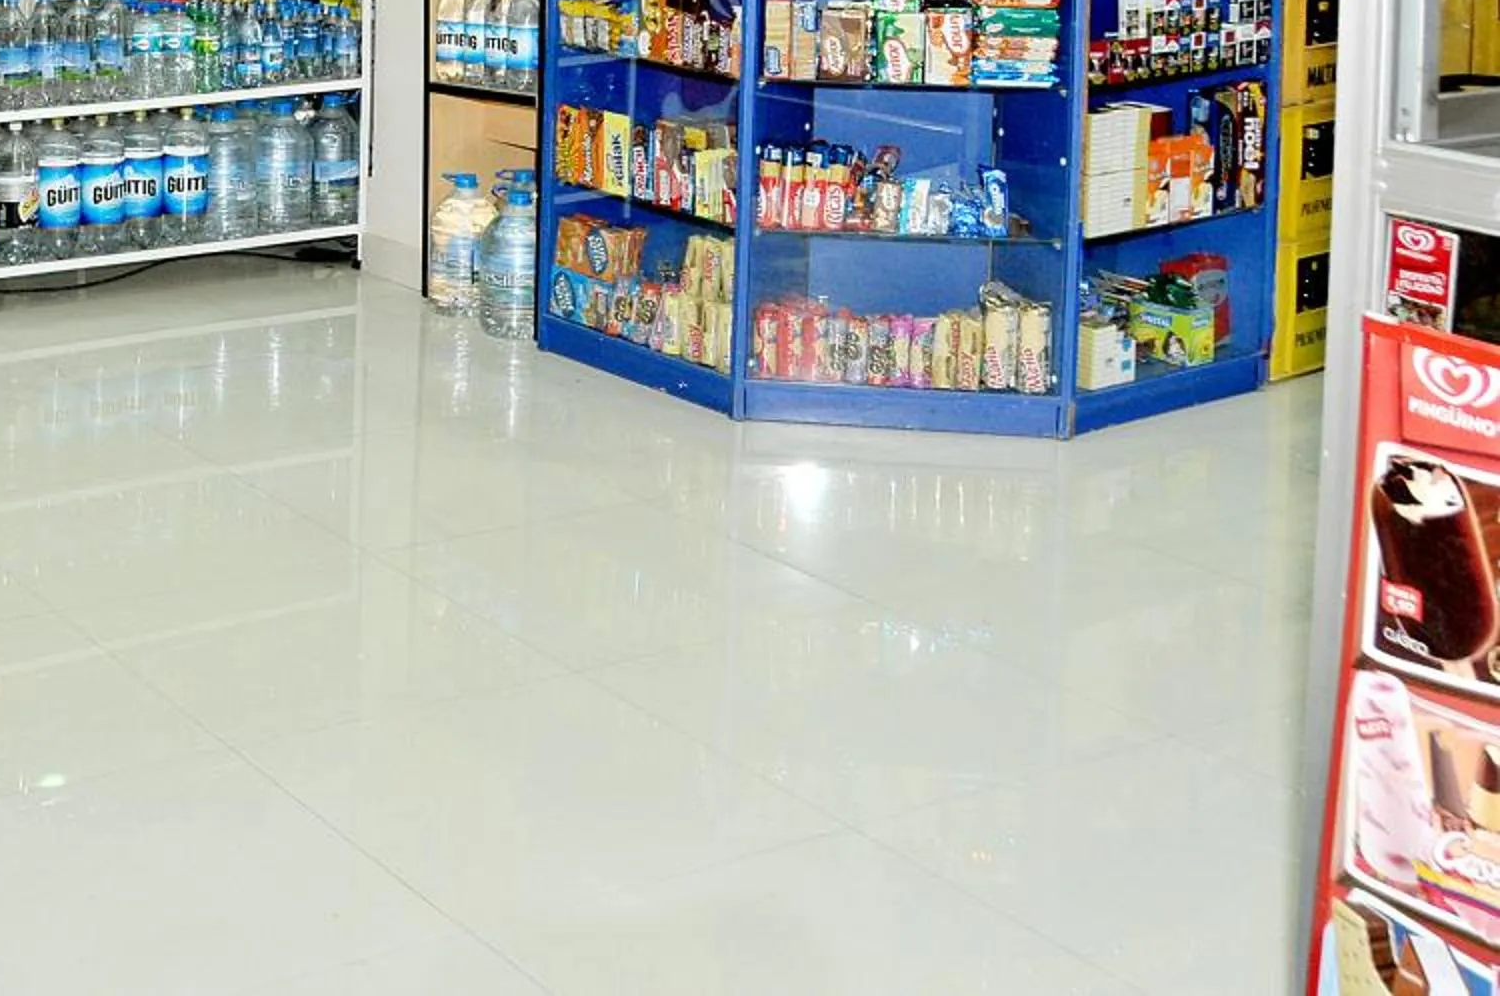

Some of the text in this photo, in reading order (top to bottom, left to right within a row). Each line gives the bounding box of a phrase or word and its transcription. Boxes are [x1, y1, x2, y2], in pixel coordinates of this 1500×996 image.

[93, 182, 125, 204] GÜIT
[167, 174, 208, 193] GÜITI
[47, 186, 79, 207] GÜIT
